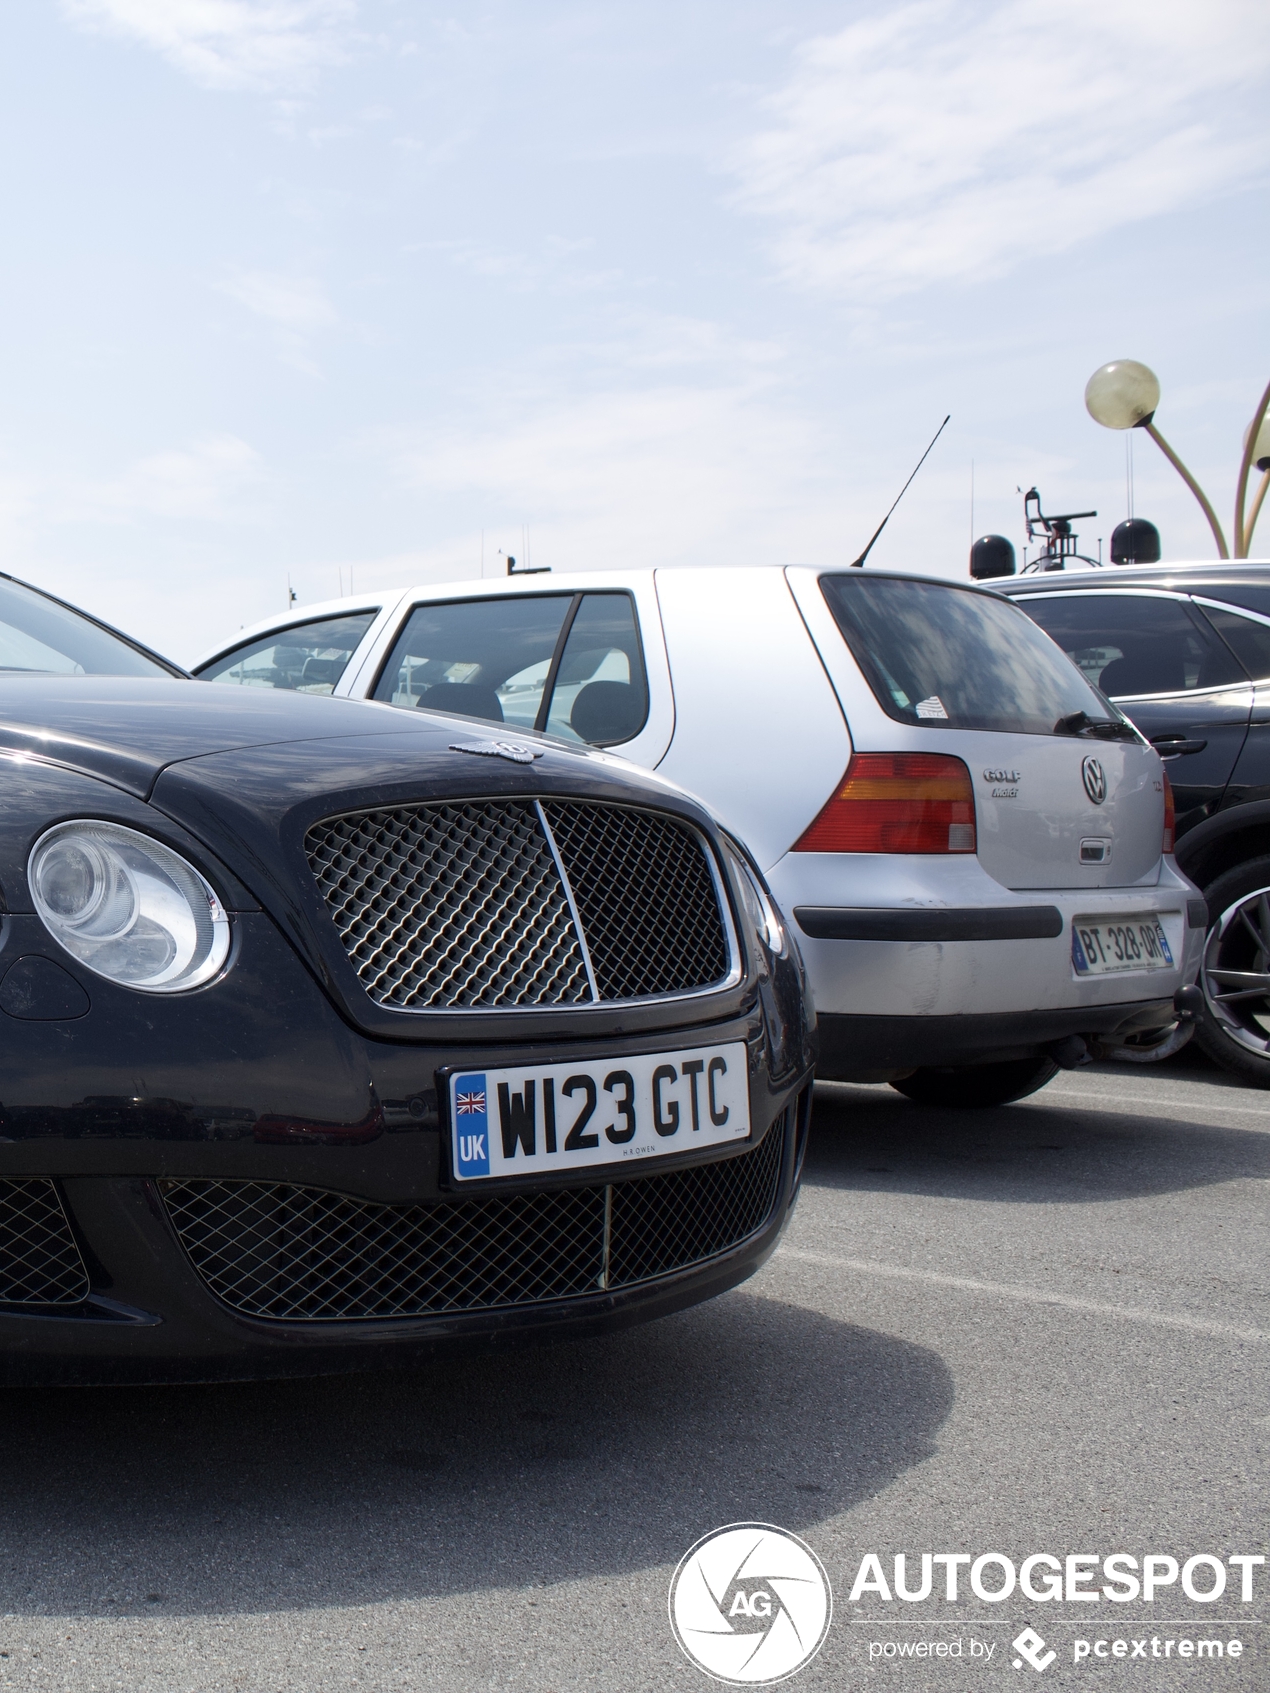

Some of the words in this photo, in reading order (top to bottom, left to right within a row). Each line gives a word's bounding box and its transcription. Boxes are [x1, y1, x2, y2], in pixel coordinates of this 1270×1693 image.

[983, 768, 1021, 783] GOLF
[652, 1056, 729, 1137] GTC
[460, 1134, 487, 1162] UK
